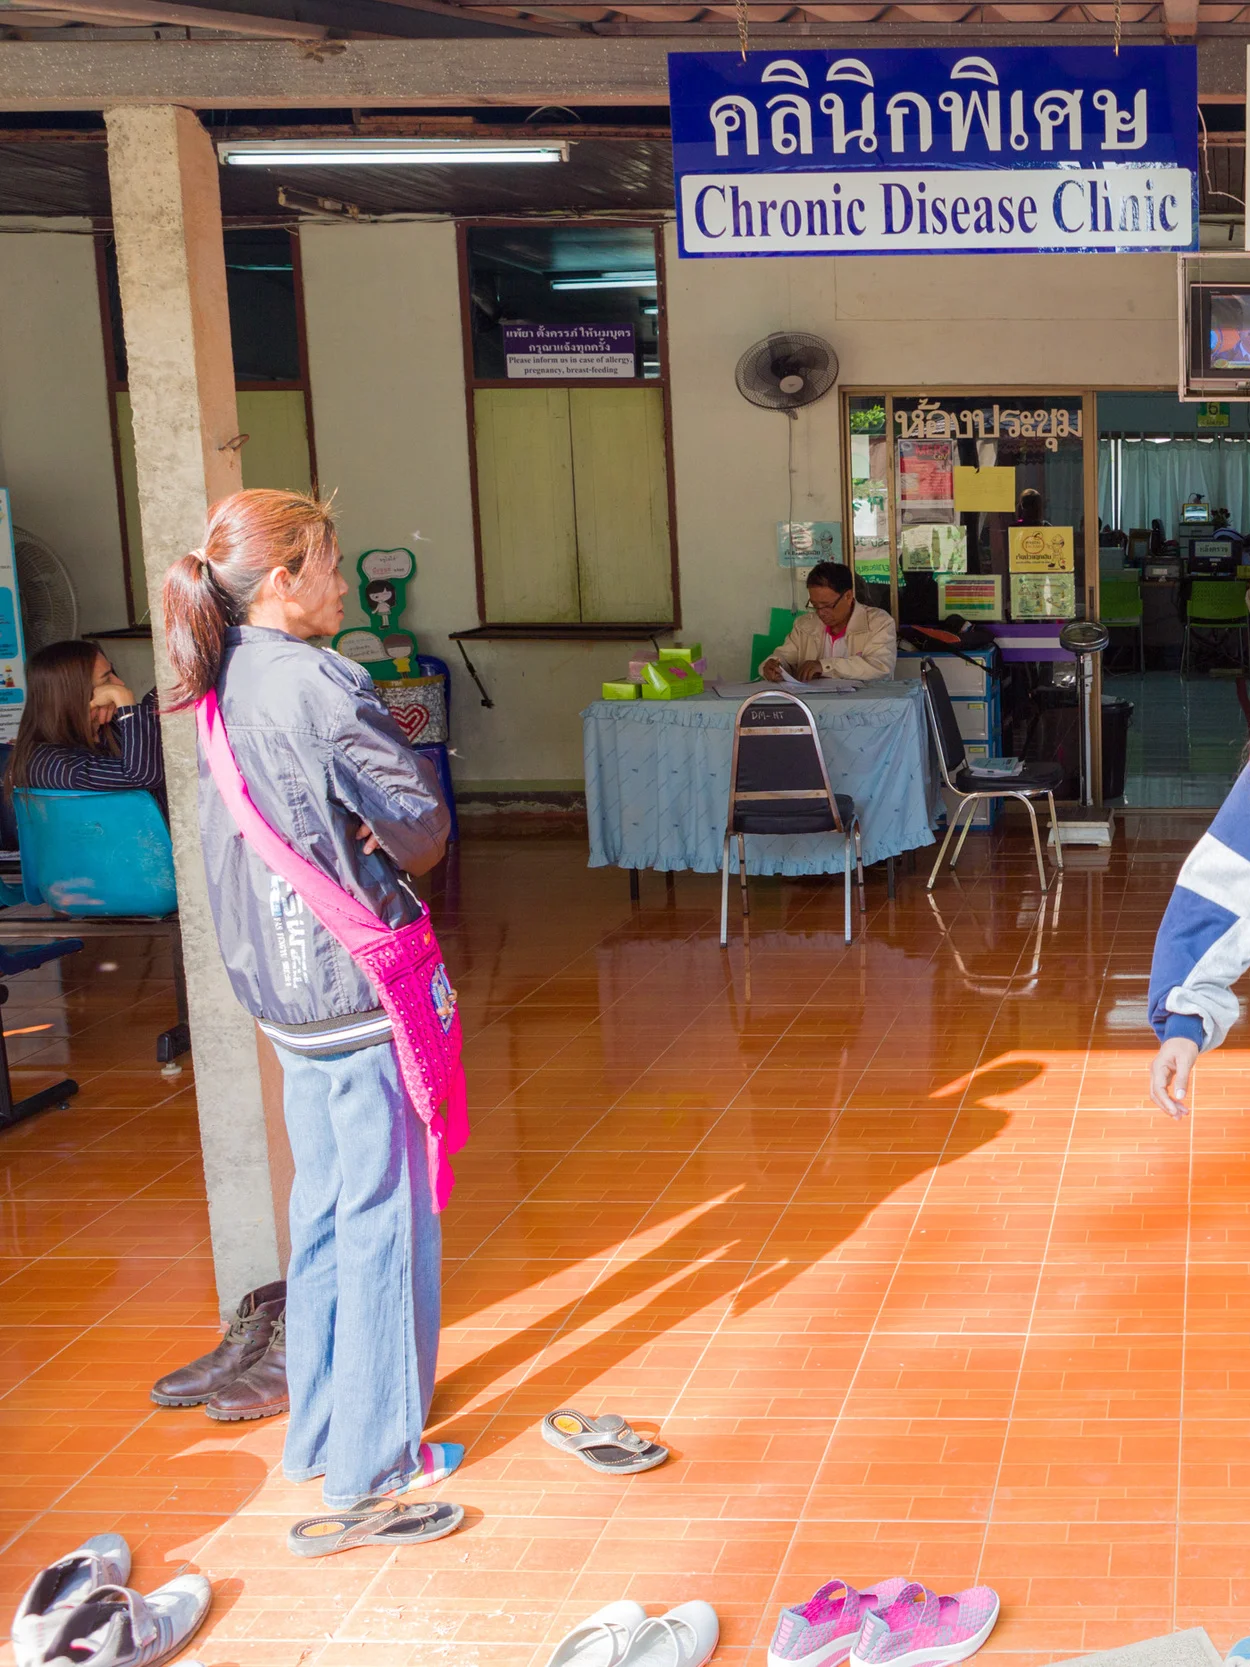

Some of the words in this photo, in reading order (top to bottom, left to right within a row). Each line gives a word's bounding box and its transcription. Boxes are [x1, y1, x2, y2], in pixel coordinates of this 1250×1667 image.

[709, 56, 1149, 157] คลินิกพิเศษ
[694, 183, 867, 240] Chronic
[879, 181, 1038, 237] Disease
[1052, 178, 1179, 235] Clinic
[506, 327, 534, 338] แพ้ยา
[536, 325, 578, 338] ตั้งครรภ์
[579, 327, 631, 340] ให้นมบุตร
[508, 356, 531, 364] Please
[533, 356, 558, 364] inform
[570, 356, 577, 364] in
[596, 356, 604, 364] of
[566, 366, 618, 375] breast-feeding
[895, 398, 1083, 453] ห้องประชุม
